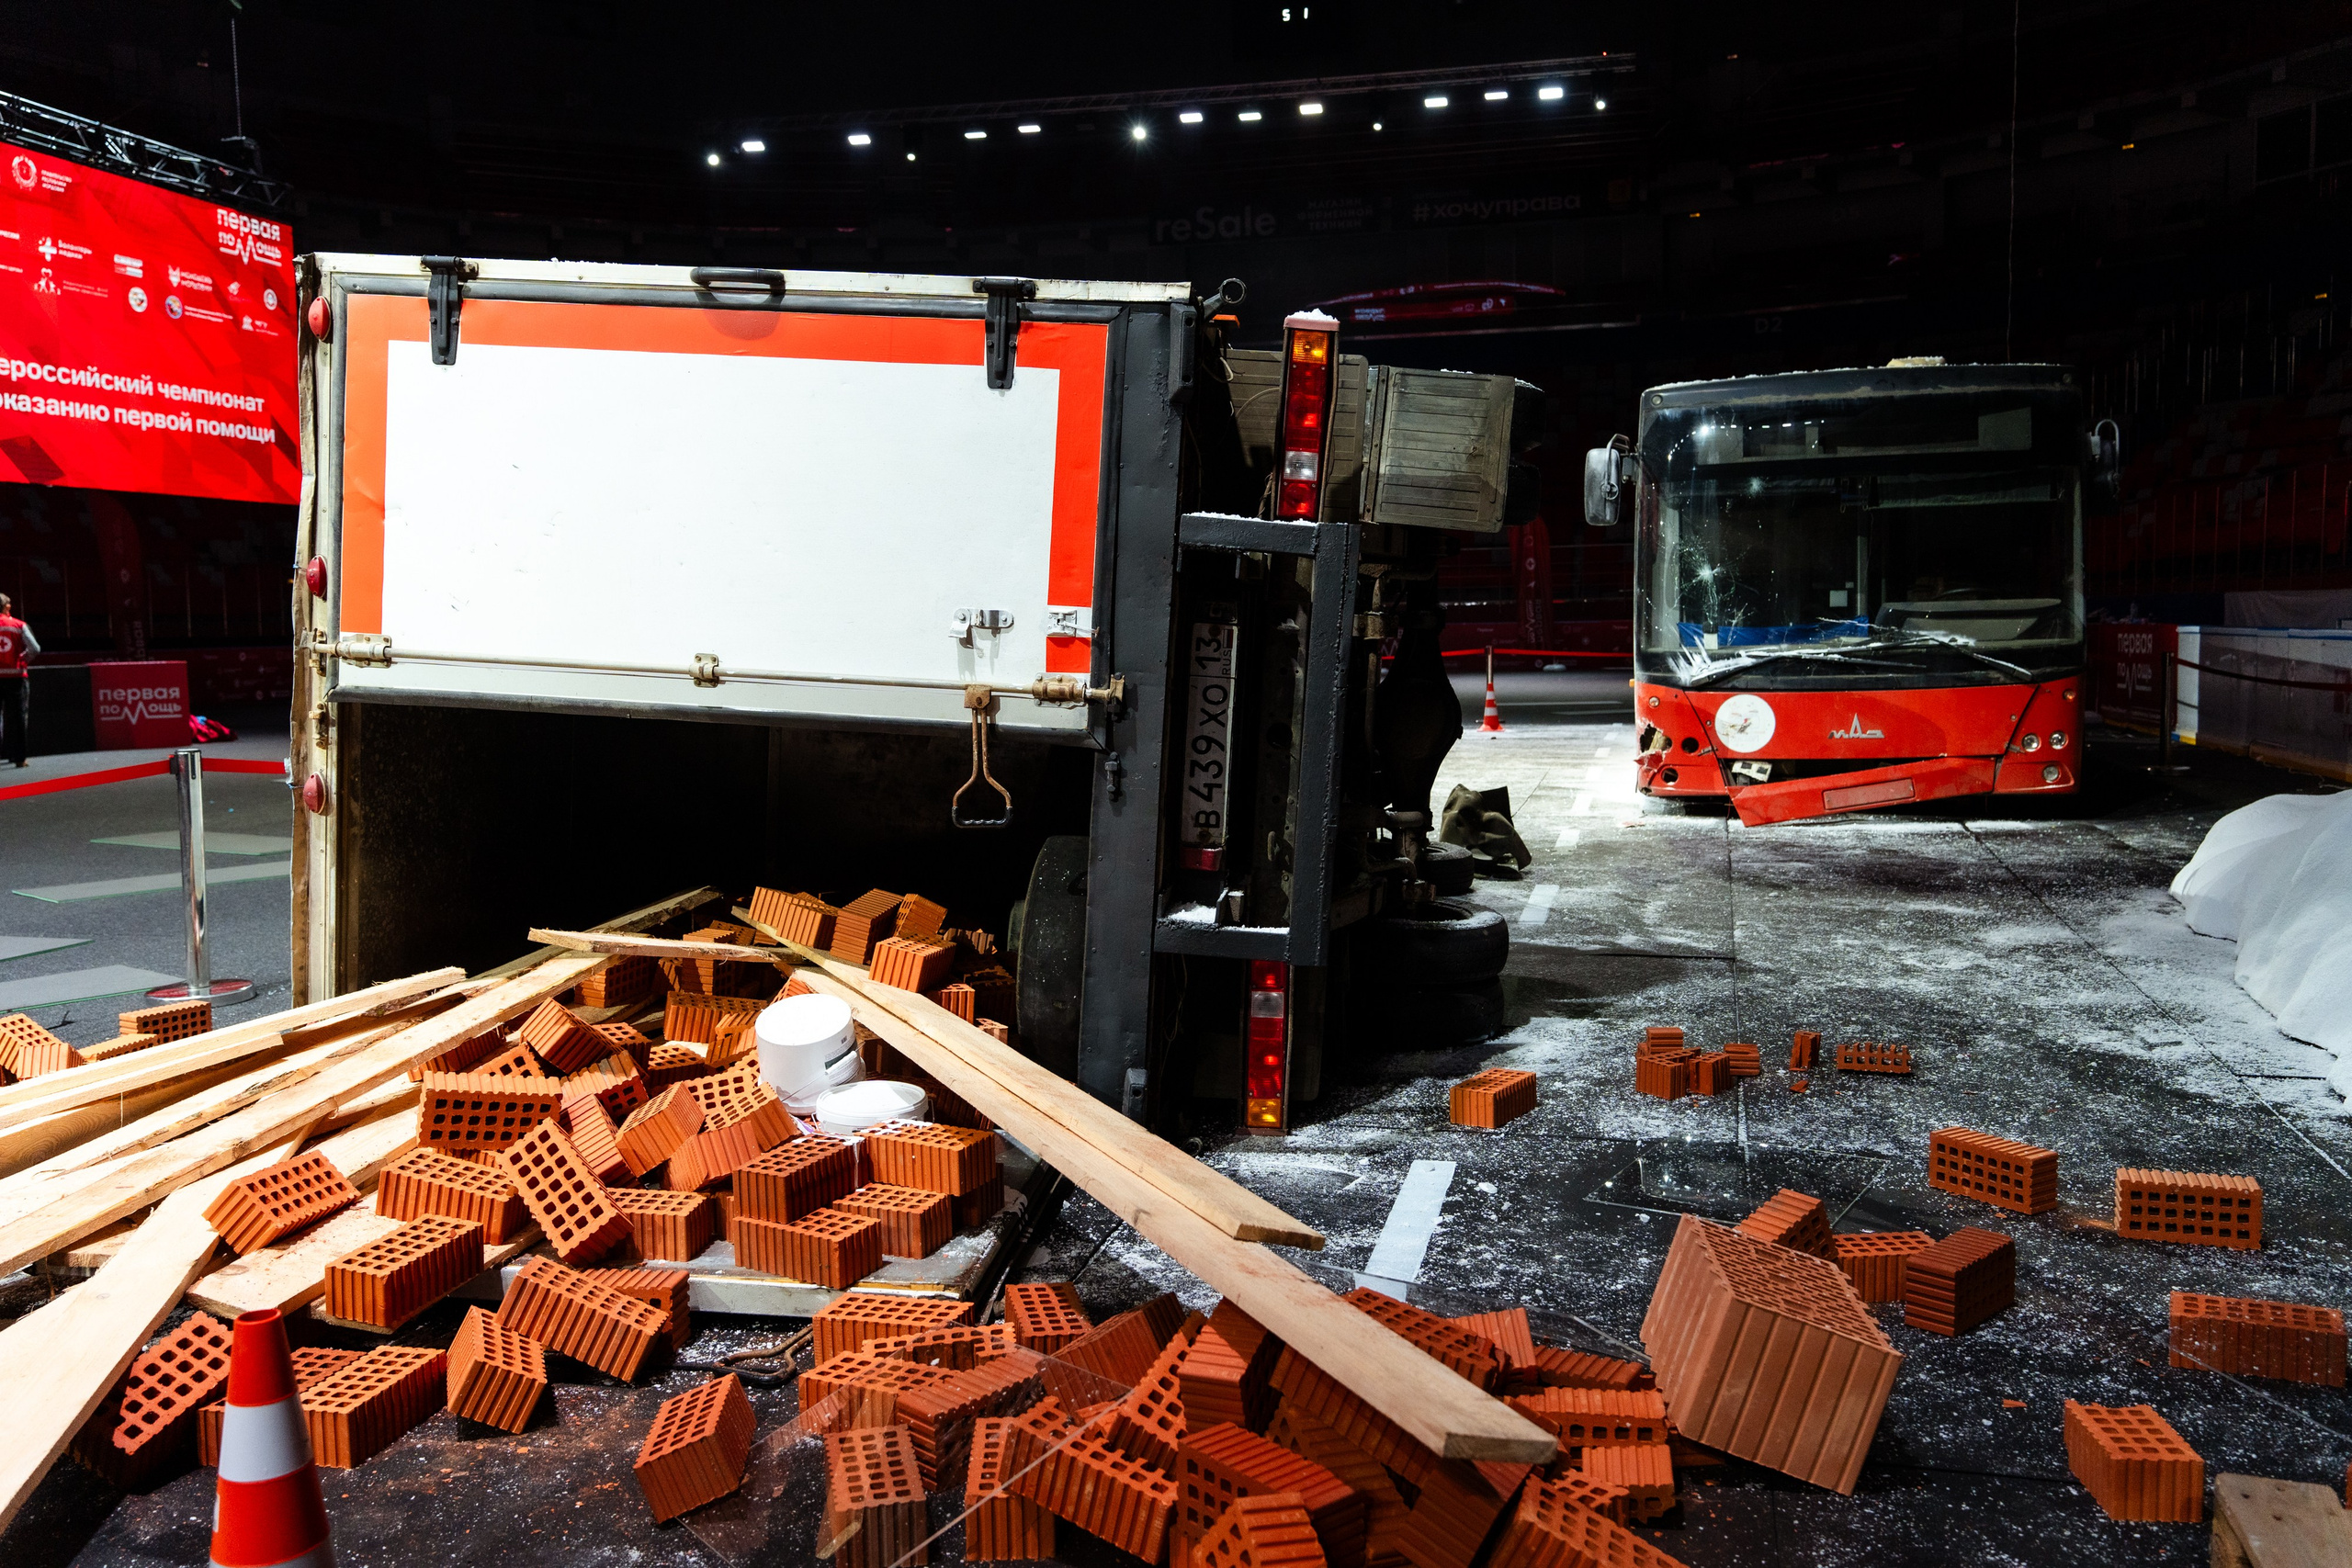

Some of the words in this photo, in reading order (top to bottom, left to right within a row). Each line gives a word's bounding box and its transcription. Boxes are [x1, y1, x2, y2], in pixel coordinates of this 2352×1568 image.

[1308, 197, 1362, 209] МАГАЗИН
[1412, 195, 1581, 221] #хочуправа
[217, 209, 280, 242] первая
[1155, 205, 1276, 242] reSale
[157, 381, 265, 412] чемпионат
[0, 393, 109, 423] казанию
[114, 407, 193, 433] первой
[196, 419, 276, 445] помощи
[1195, 636, 1221, 671] 13
[2117, 632, 2153, 658] первая
[1222, 649, 1232, 675] RUS
[99, 686, 181, 705] первая
